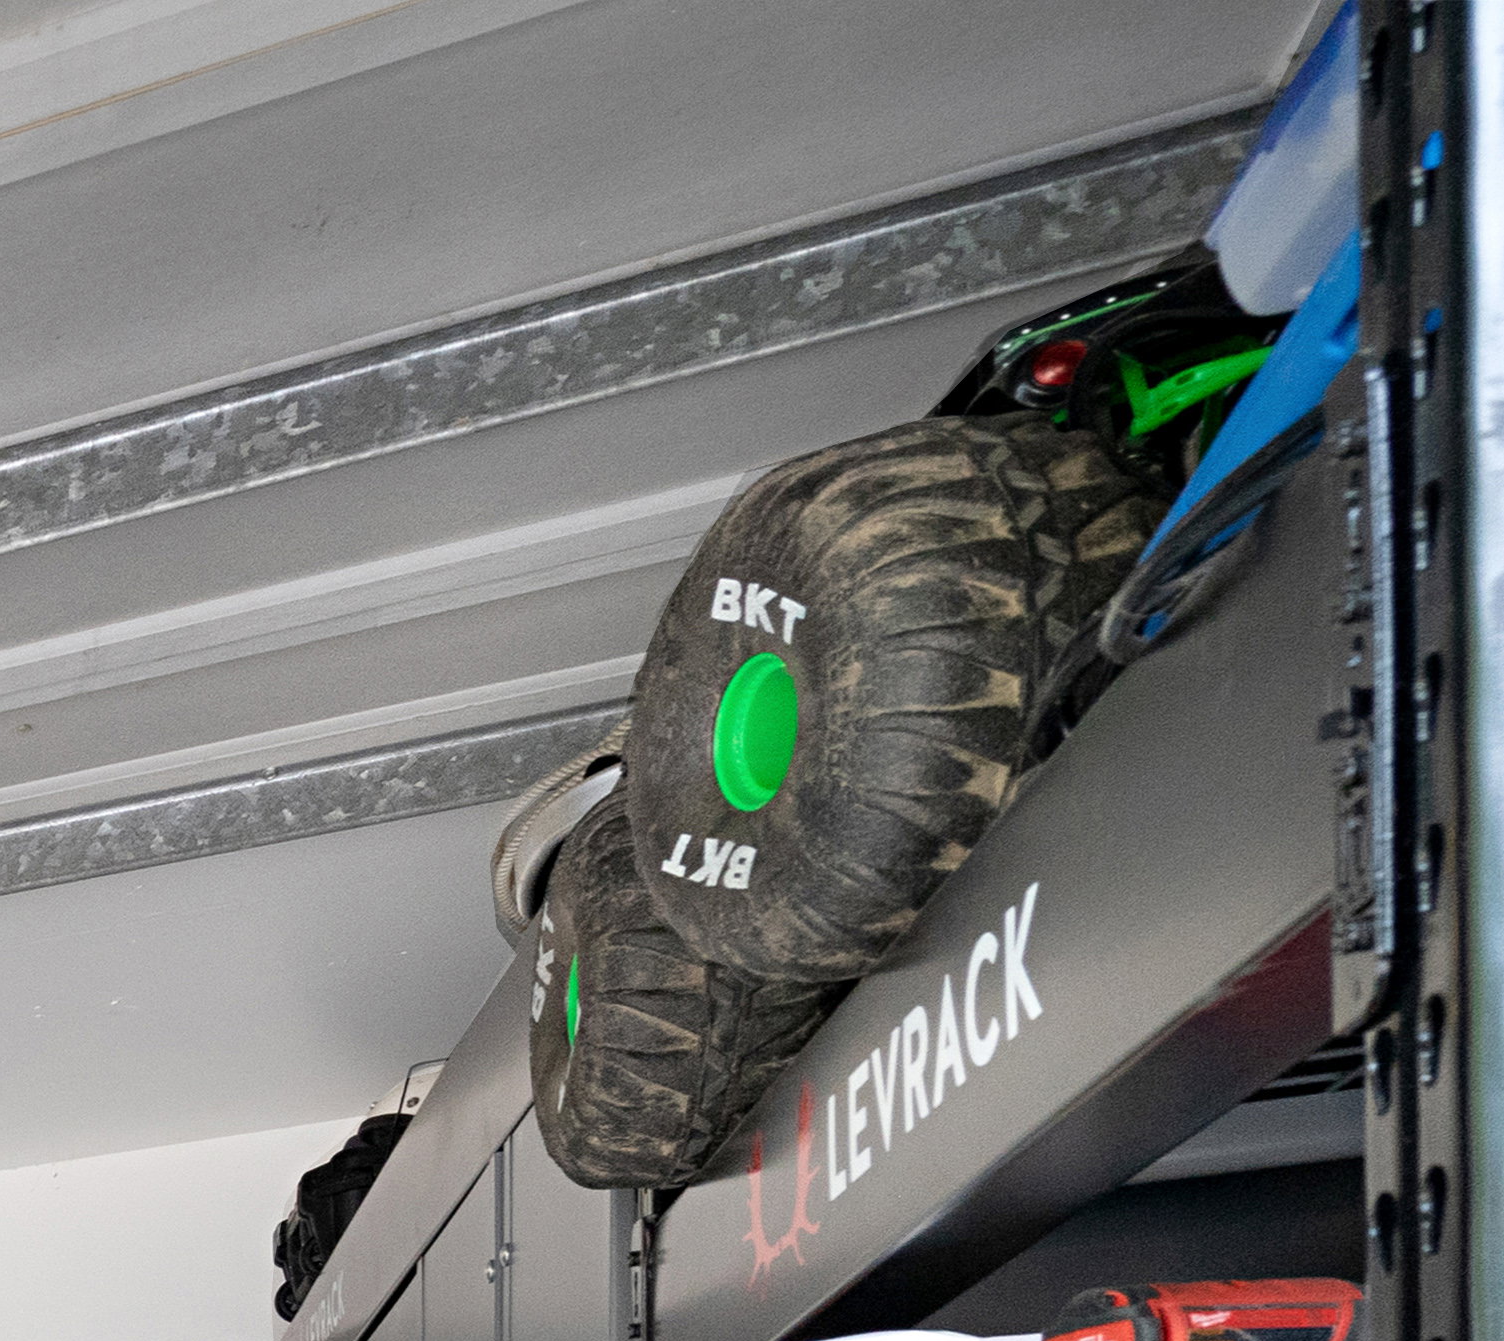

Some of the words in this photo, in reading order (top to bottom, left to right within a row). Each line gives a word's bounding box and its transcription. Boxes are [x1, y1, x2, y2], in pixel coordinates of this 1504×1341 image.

[710, 577, 807, 645] BKT
[660, 834, 758, 890] BKT
[825, 881, 1044, 1201] LEVRACK
